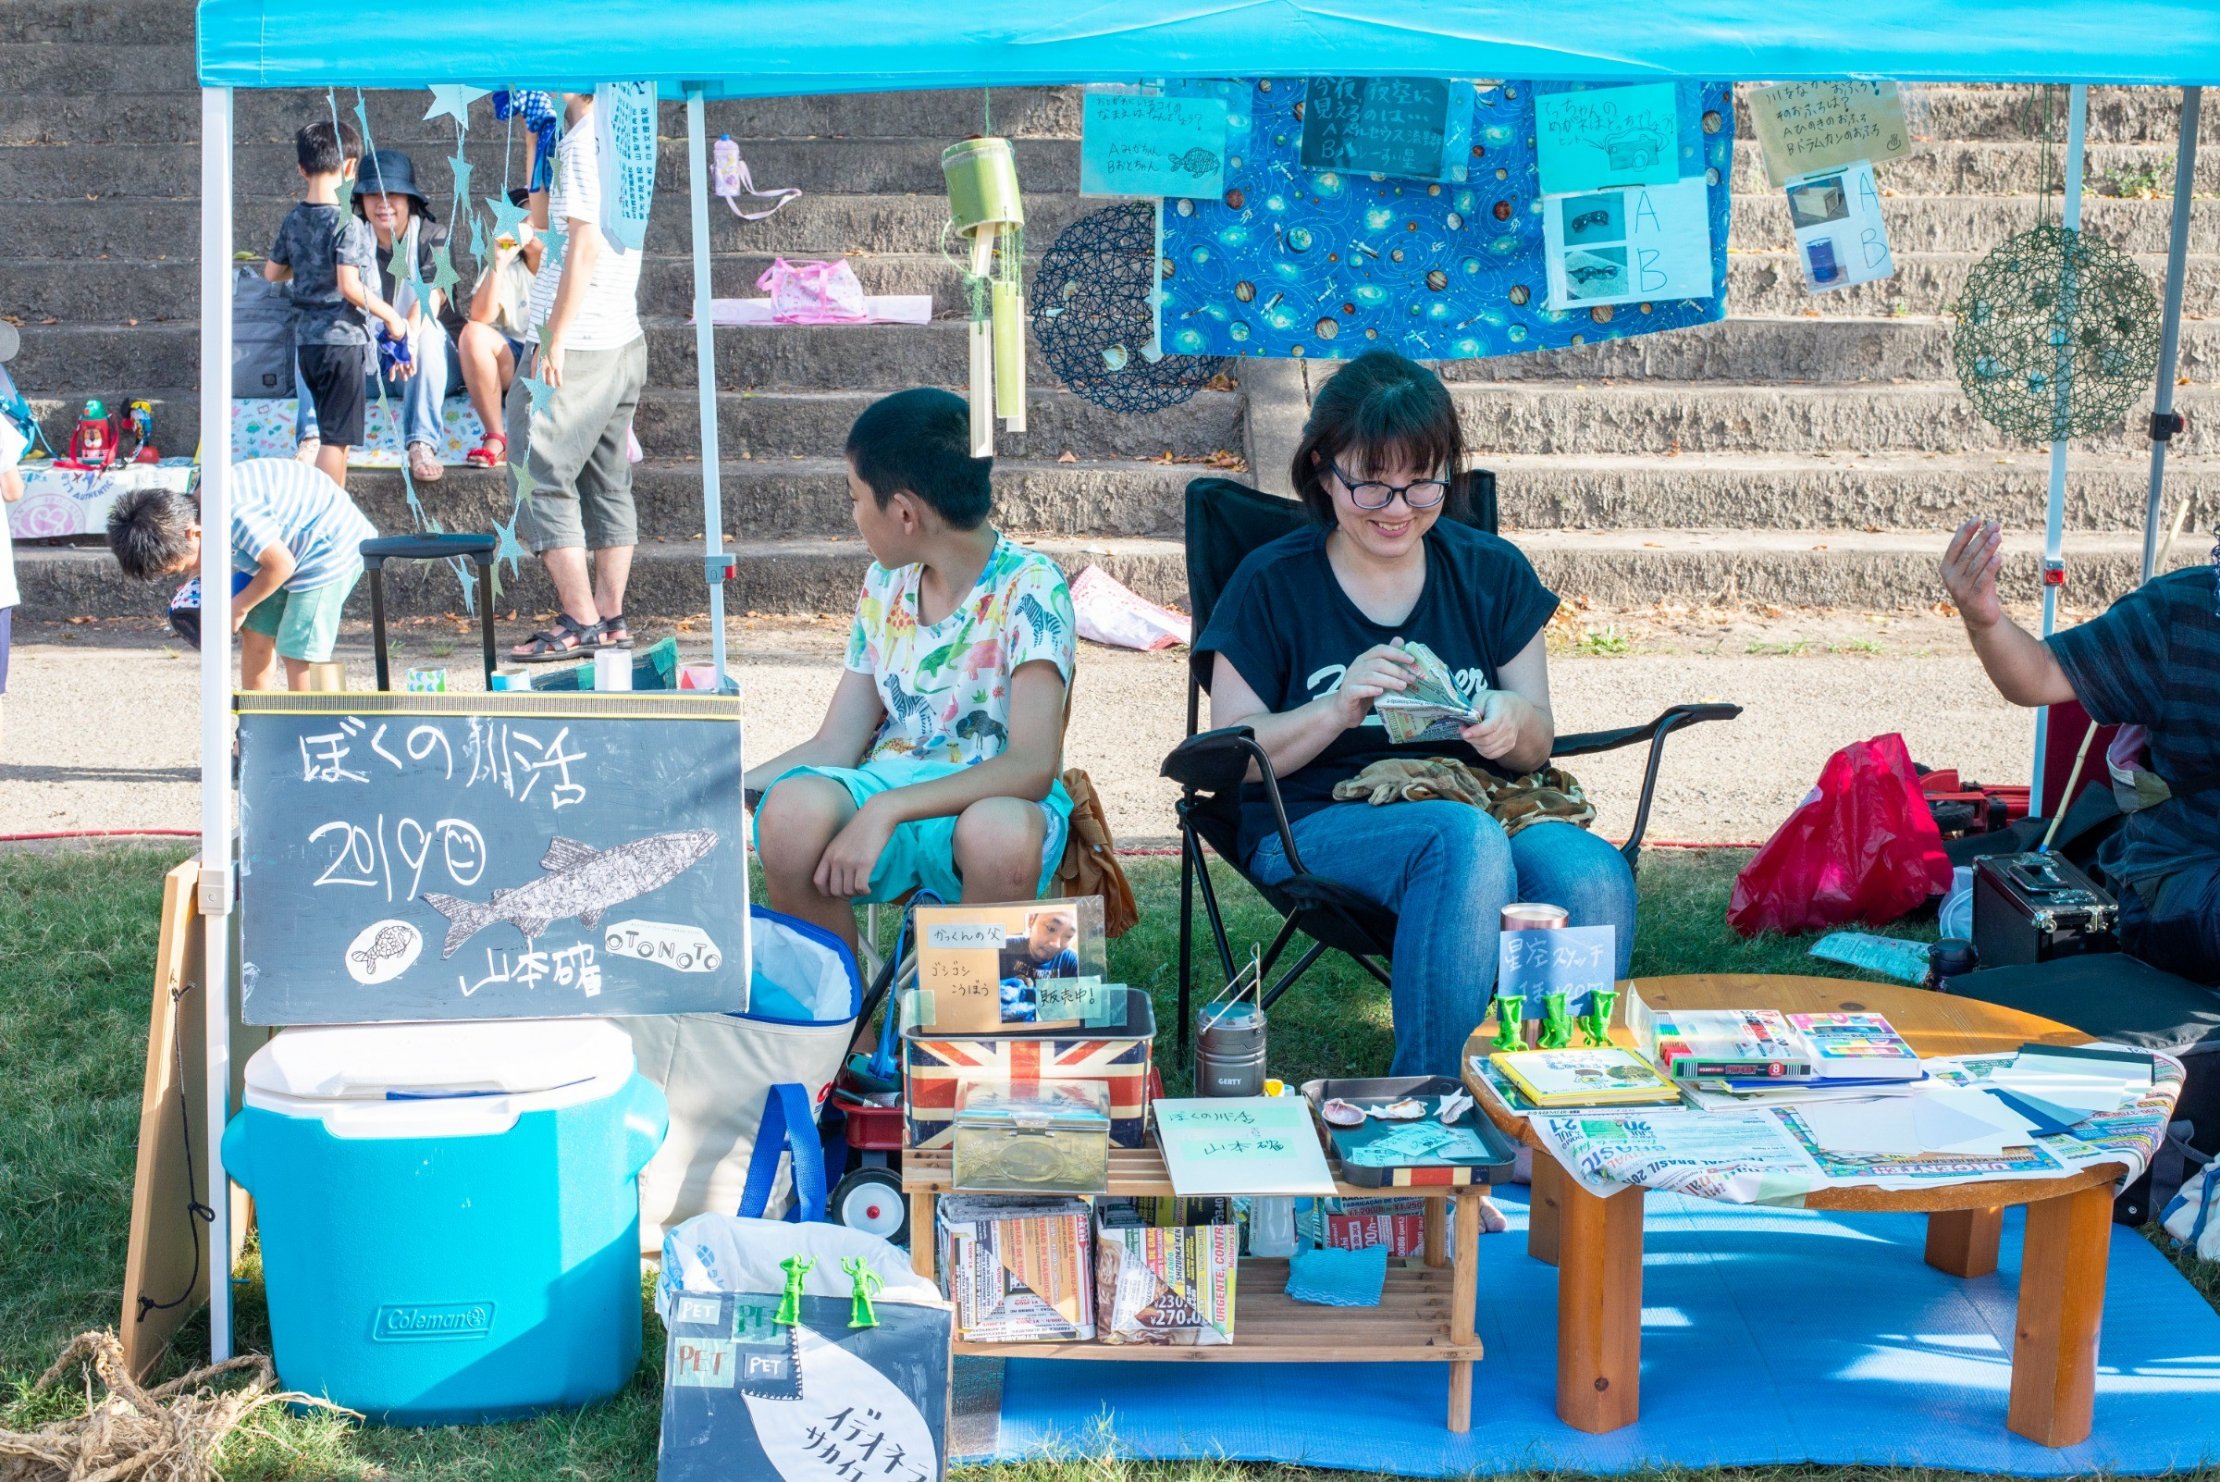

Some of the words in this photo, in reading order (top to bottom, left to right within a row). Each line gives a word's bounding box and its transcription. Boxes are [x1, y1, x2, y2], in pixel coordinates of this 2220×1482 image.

[1859, 173, 1878, 211] A
[1635, 192, 1660, 233] A
[1861, 228, 1887, 269] B
[1638, 248, 1667, 292] B
[386, 1308, 468, 1330] Coleman
[682, 1301, 716, 1319] PET
[679, 1345, 729, 1376] PET
[750, 1357, 781, 1375] PET
